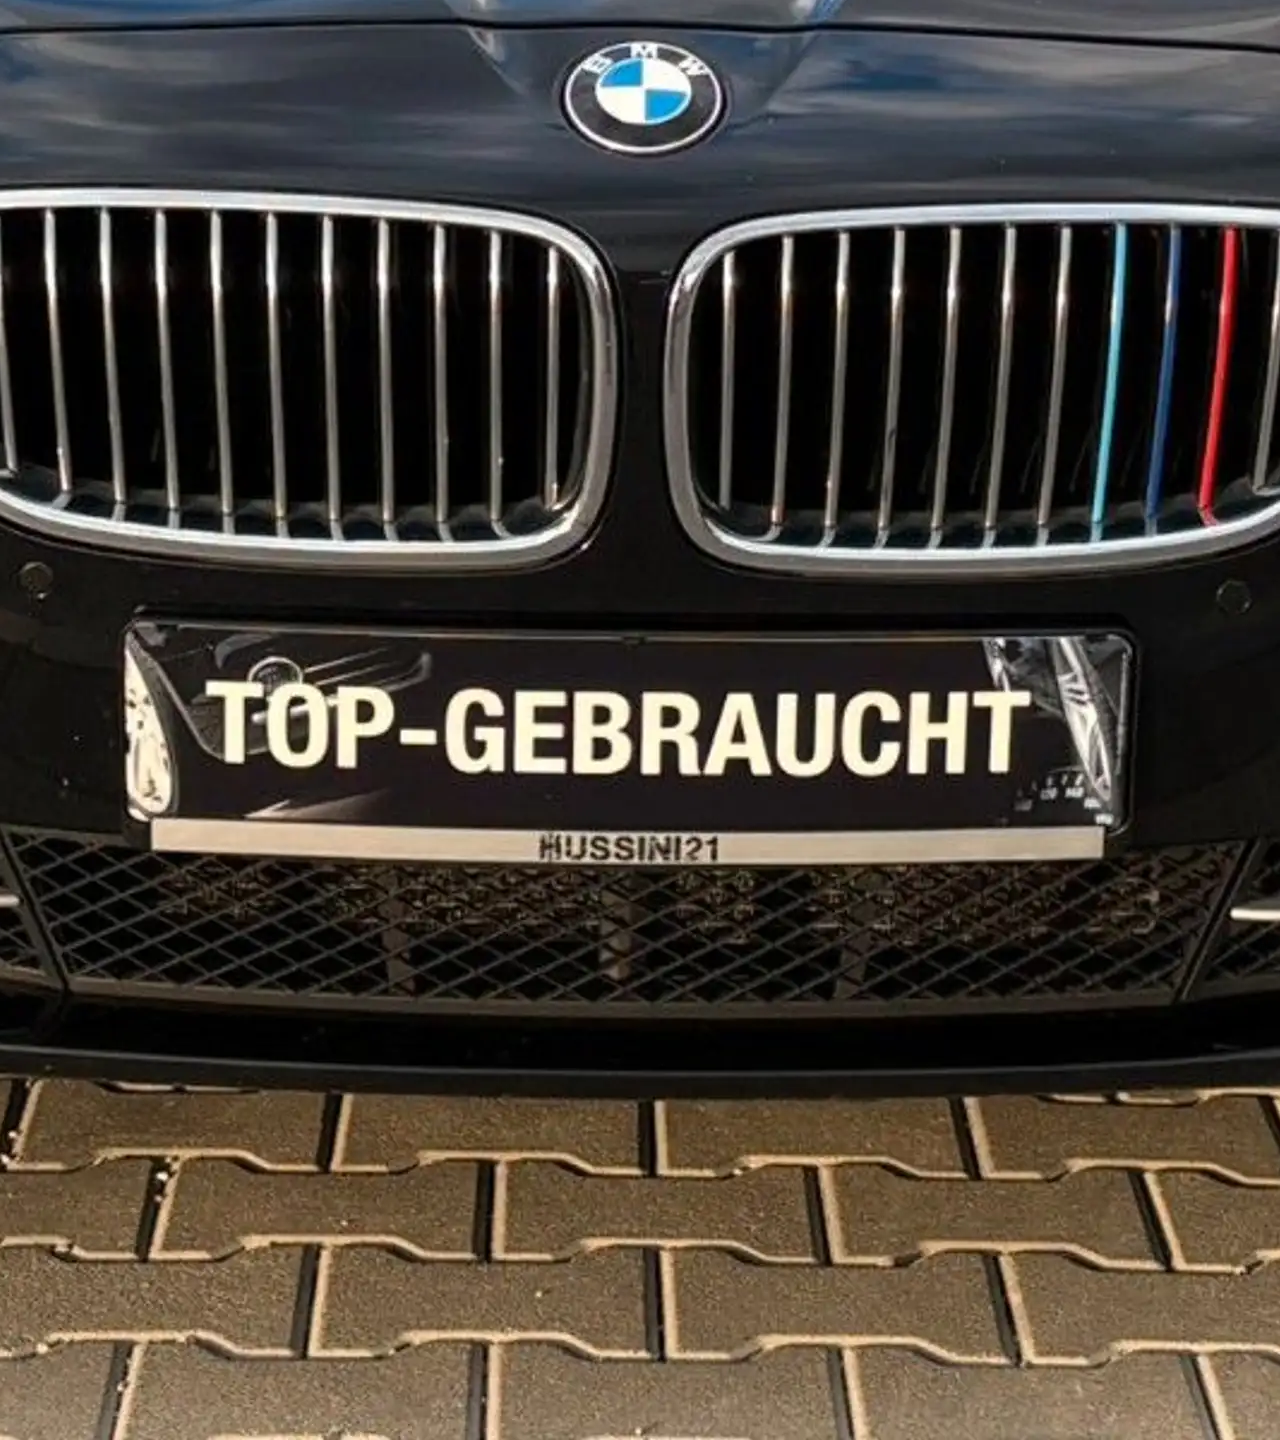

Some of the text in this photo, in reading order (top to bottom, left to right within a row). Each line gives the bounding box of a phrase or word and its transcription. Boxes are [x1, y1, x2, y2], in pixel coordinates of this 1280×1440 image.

[579, 43, 711, 77] BMW
[205, 679, 1032, 777] TOP-GEBRAUCHT
[538, 834, 720, 862] HUSSINI21
